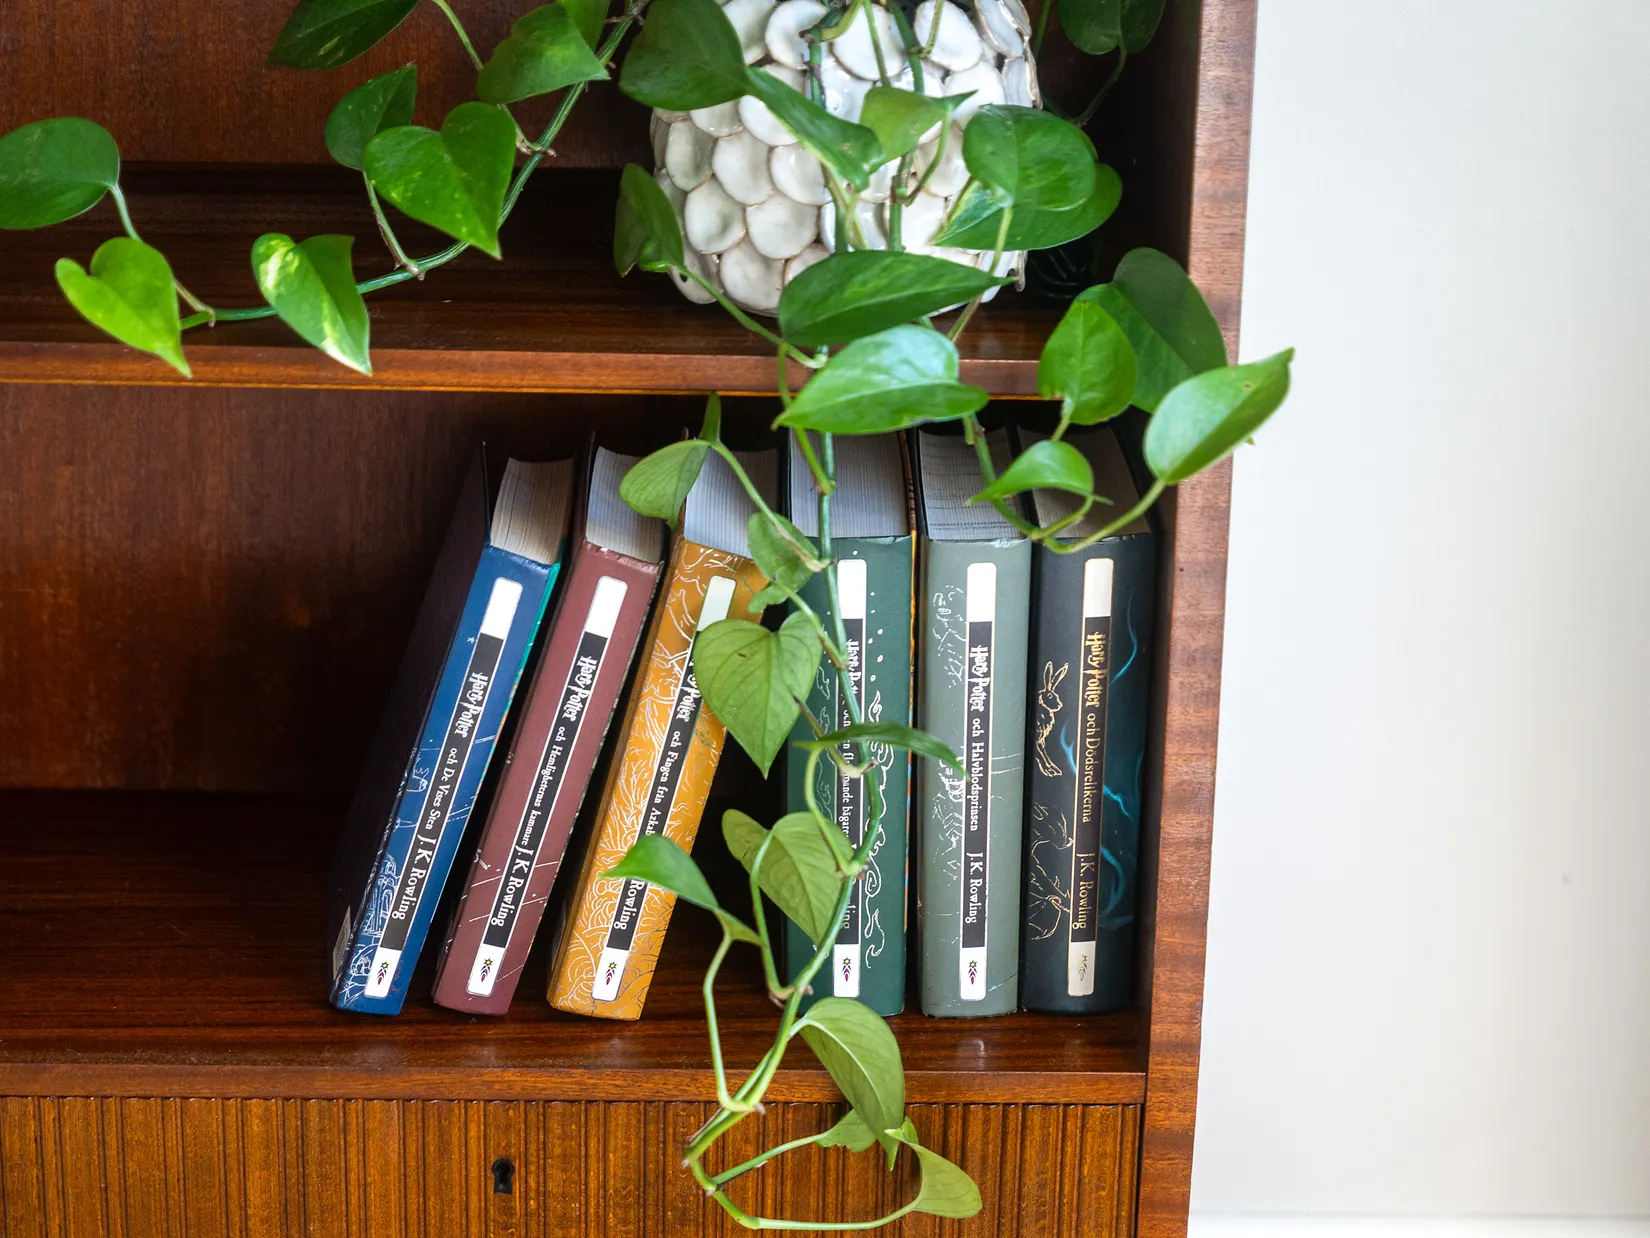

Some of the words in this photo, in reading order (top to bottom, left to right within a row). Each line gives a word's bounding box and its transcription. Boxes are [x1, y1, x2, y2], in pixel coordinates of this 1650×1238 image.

[969, 644, 989, 678] Harry
[1085, 631, 1106, 668] Harry
[465, 672, 489, 704] Harry
[574, 655, 597, 689] Harry
[1082, 665, 1109, 708] Potter
[561, 684, 591, 722] Potter
[675, 684, 702, 723] Potter
[968, 676, 991, 713] Potter
[454, 701, 482, 738] Potter
[554, 726, 566, 742] och
[972, 717, 985, 738] och
[1086, 712, 1101, 736] och
[446, 748, 458, 765] och
[669, 730, 682, 748] och
[441, 768, 455, 782] De
[533, 744, 563, 808] Hemligheternas
[967, 742, 985, 832] Halvblodsprinsen
[1082, 737, 1101, 824] Dödsrelikerna
[432, 784, 450, 808] Vises
[425, 808, 441, 830] Sten
[521, 809, 542, 847] kammare
[645, 805, 662, 836] Azkab
[838, 804, 854, 838] bägare
[391, 868, 426, 921] Rowling
[490, 875, 524, 928] Rowling
[613, 879, 646, 930] Rowling
[964, 878, 983, 924] Rowling
[1072, 881, 1095, 930] Rowling
